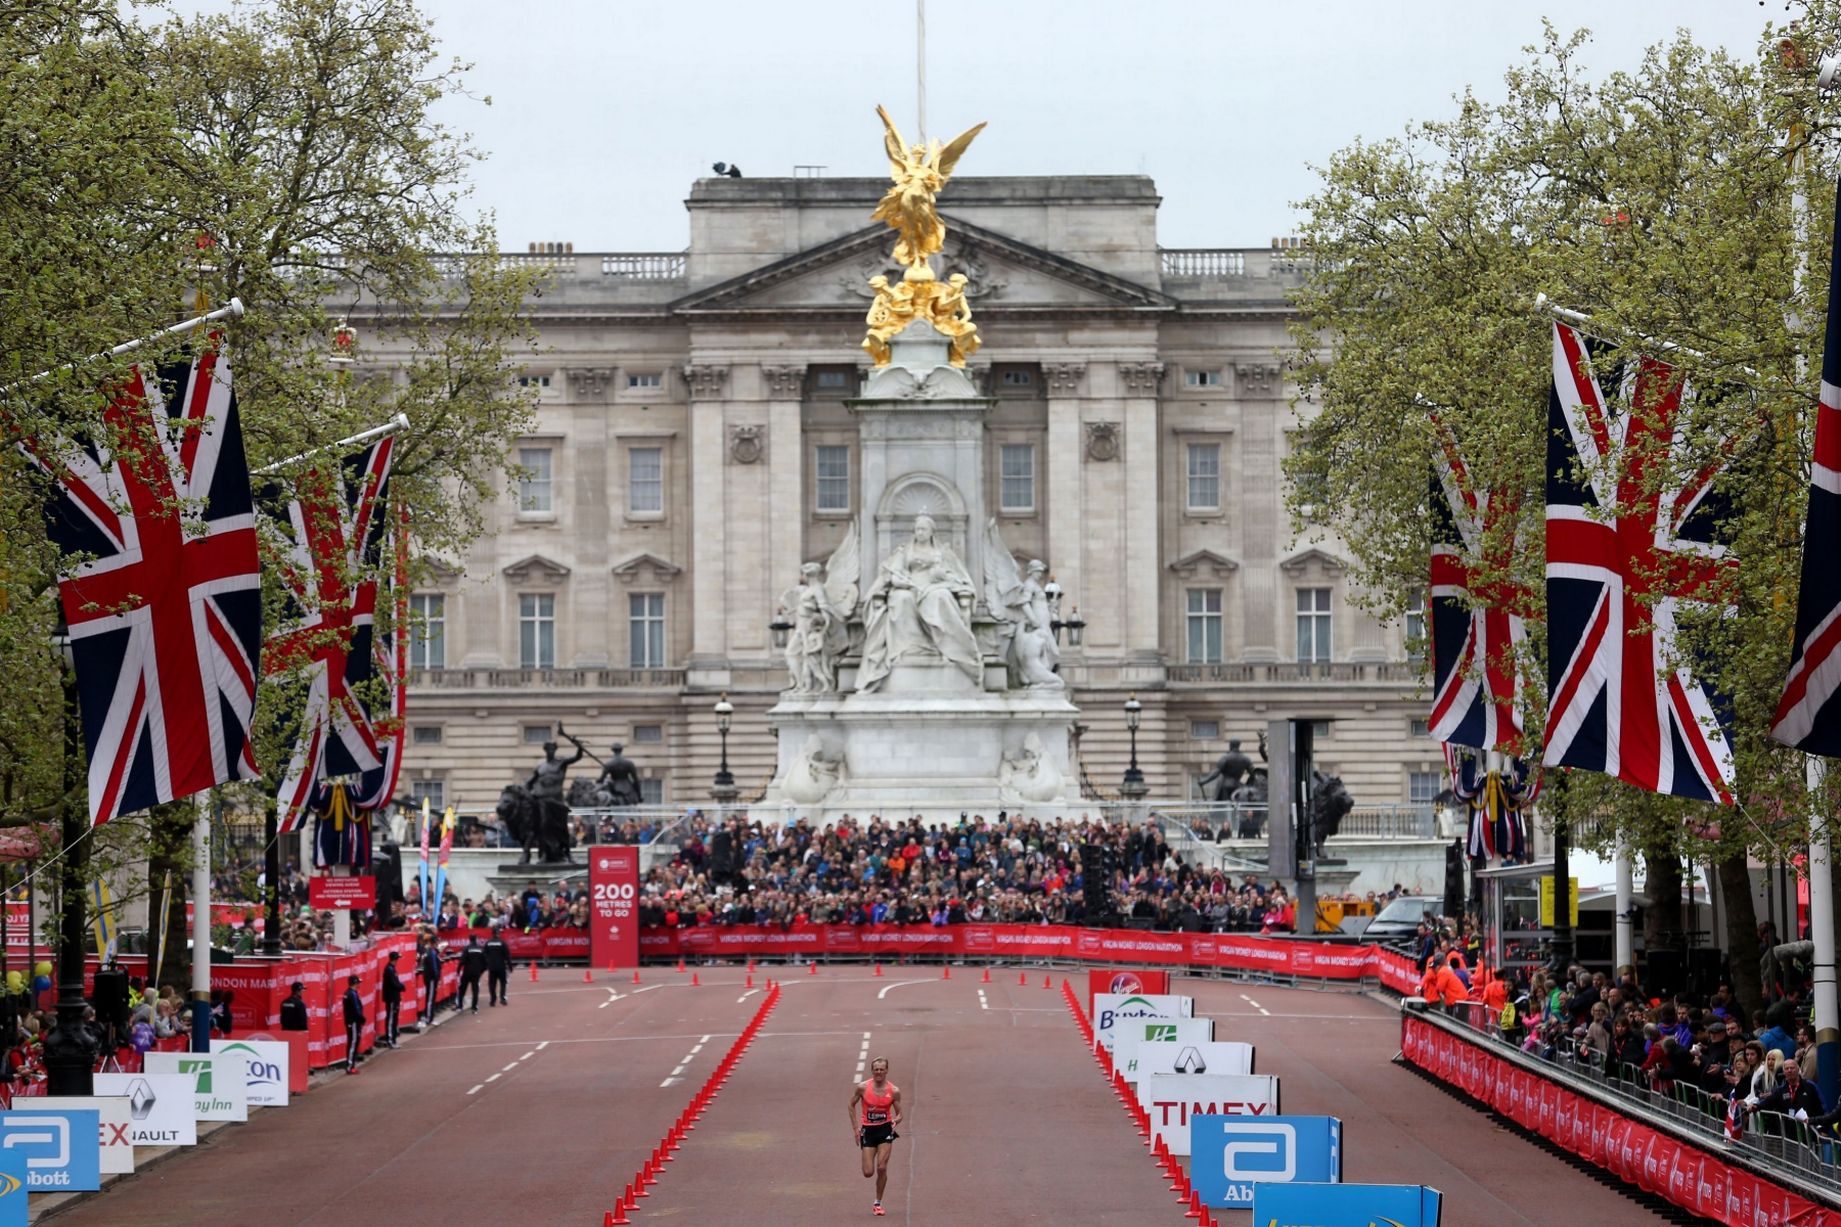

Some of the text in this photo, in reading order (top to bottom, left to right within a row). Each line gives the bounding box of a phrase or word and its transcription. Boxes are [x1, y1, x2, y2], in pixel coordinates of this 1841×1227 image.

[594, 884, 634, 900] 200
[546, 937, 572, 945] VIRGIN
[212, 1098, 232, 1110] Inn
[1153, 1101, 1267, 1126] TIMEX
